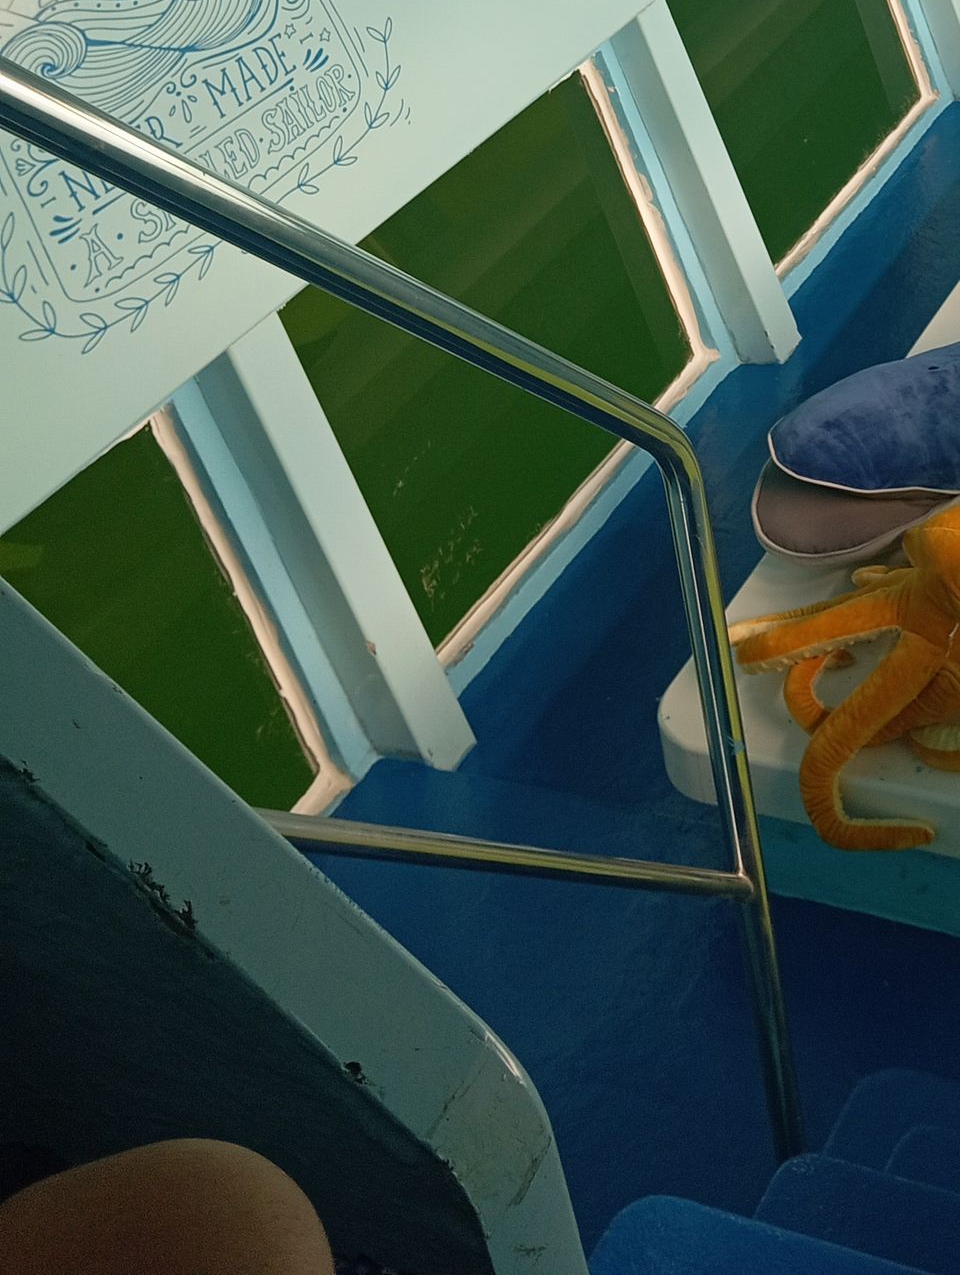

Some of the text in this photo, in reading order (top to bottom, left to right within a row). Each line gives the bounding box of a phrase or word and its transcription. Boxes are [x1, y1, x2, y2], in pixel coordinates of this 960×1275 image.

[201, 32, 298, 119] MADE
[78, 223, 125, 288] A
[260, 64, 356, 155] SAILOR
